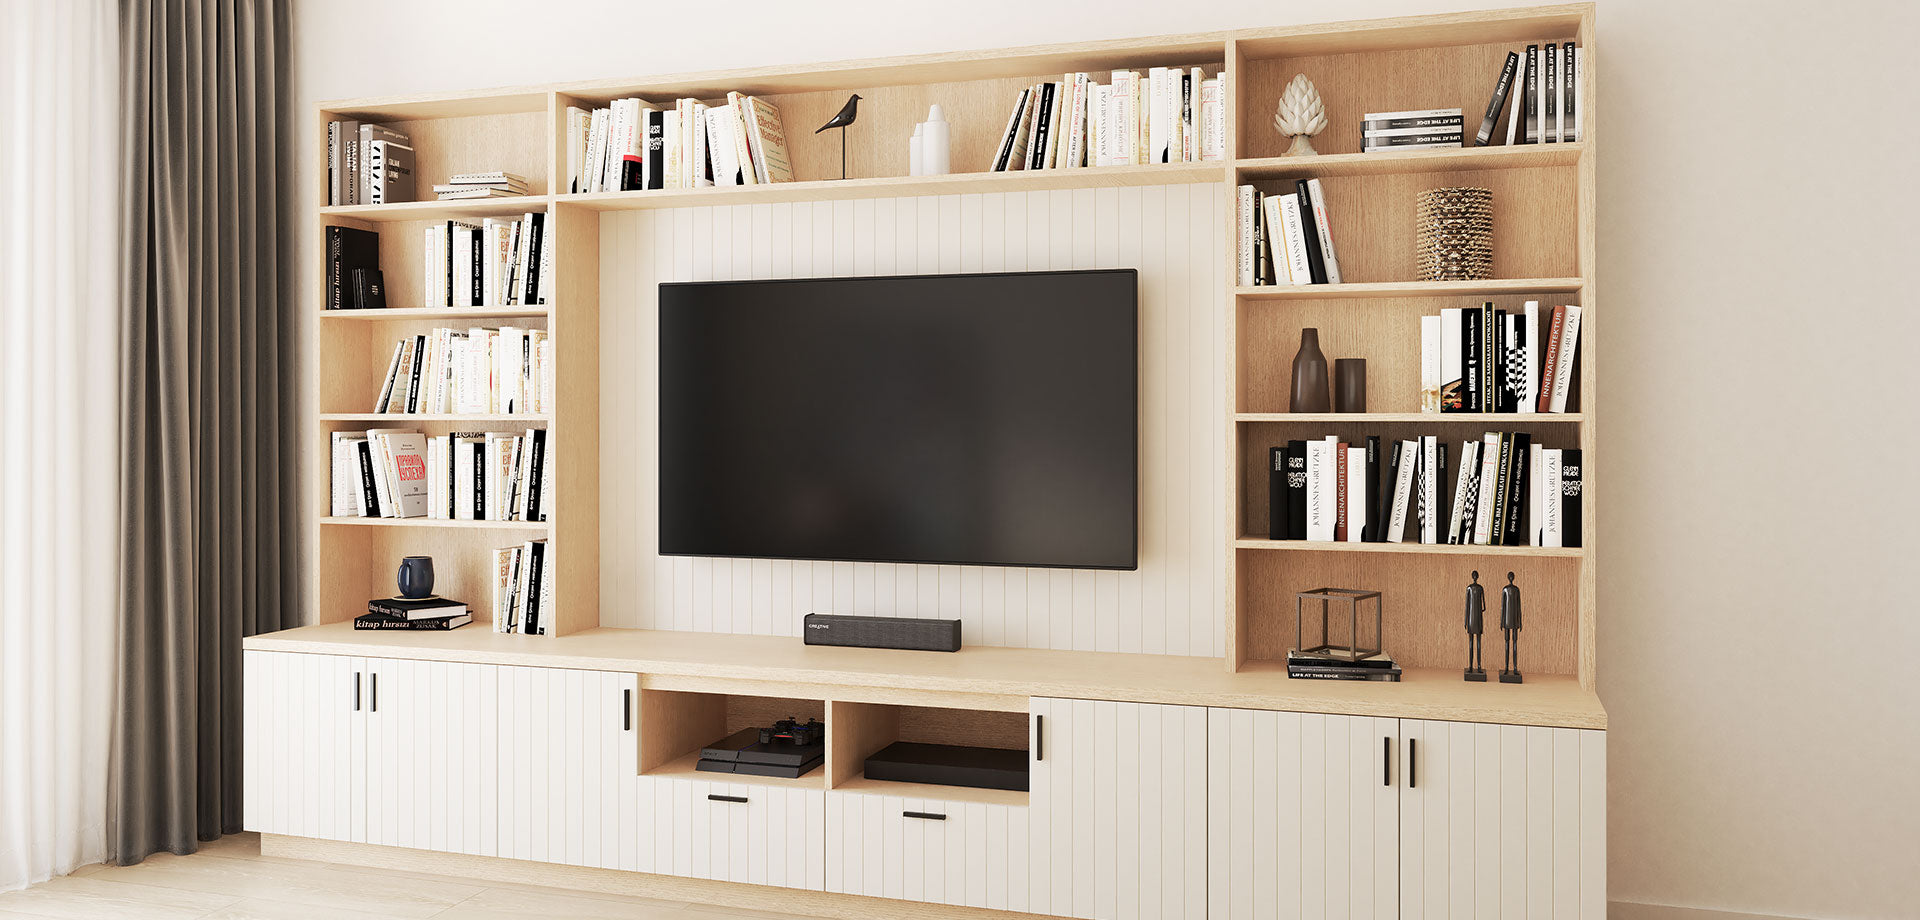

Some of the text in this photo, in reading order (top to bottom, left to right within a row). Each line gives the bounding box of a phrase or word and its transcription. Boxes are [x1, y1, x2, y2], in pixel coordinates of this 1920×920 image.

[1496, 55, 1516, 96] LIFE AT THE EDGE
[1543, 312, 1562, 397] INNENARCHITEKTUR
[356, 620, 380, 629] kitap
